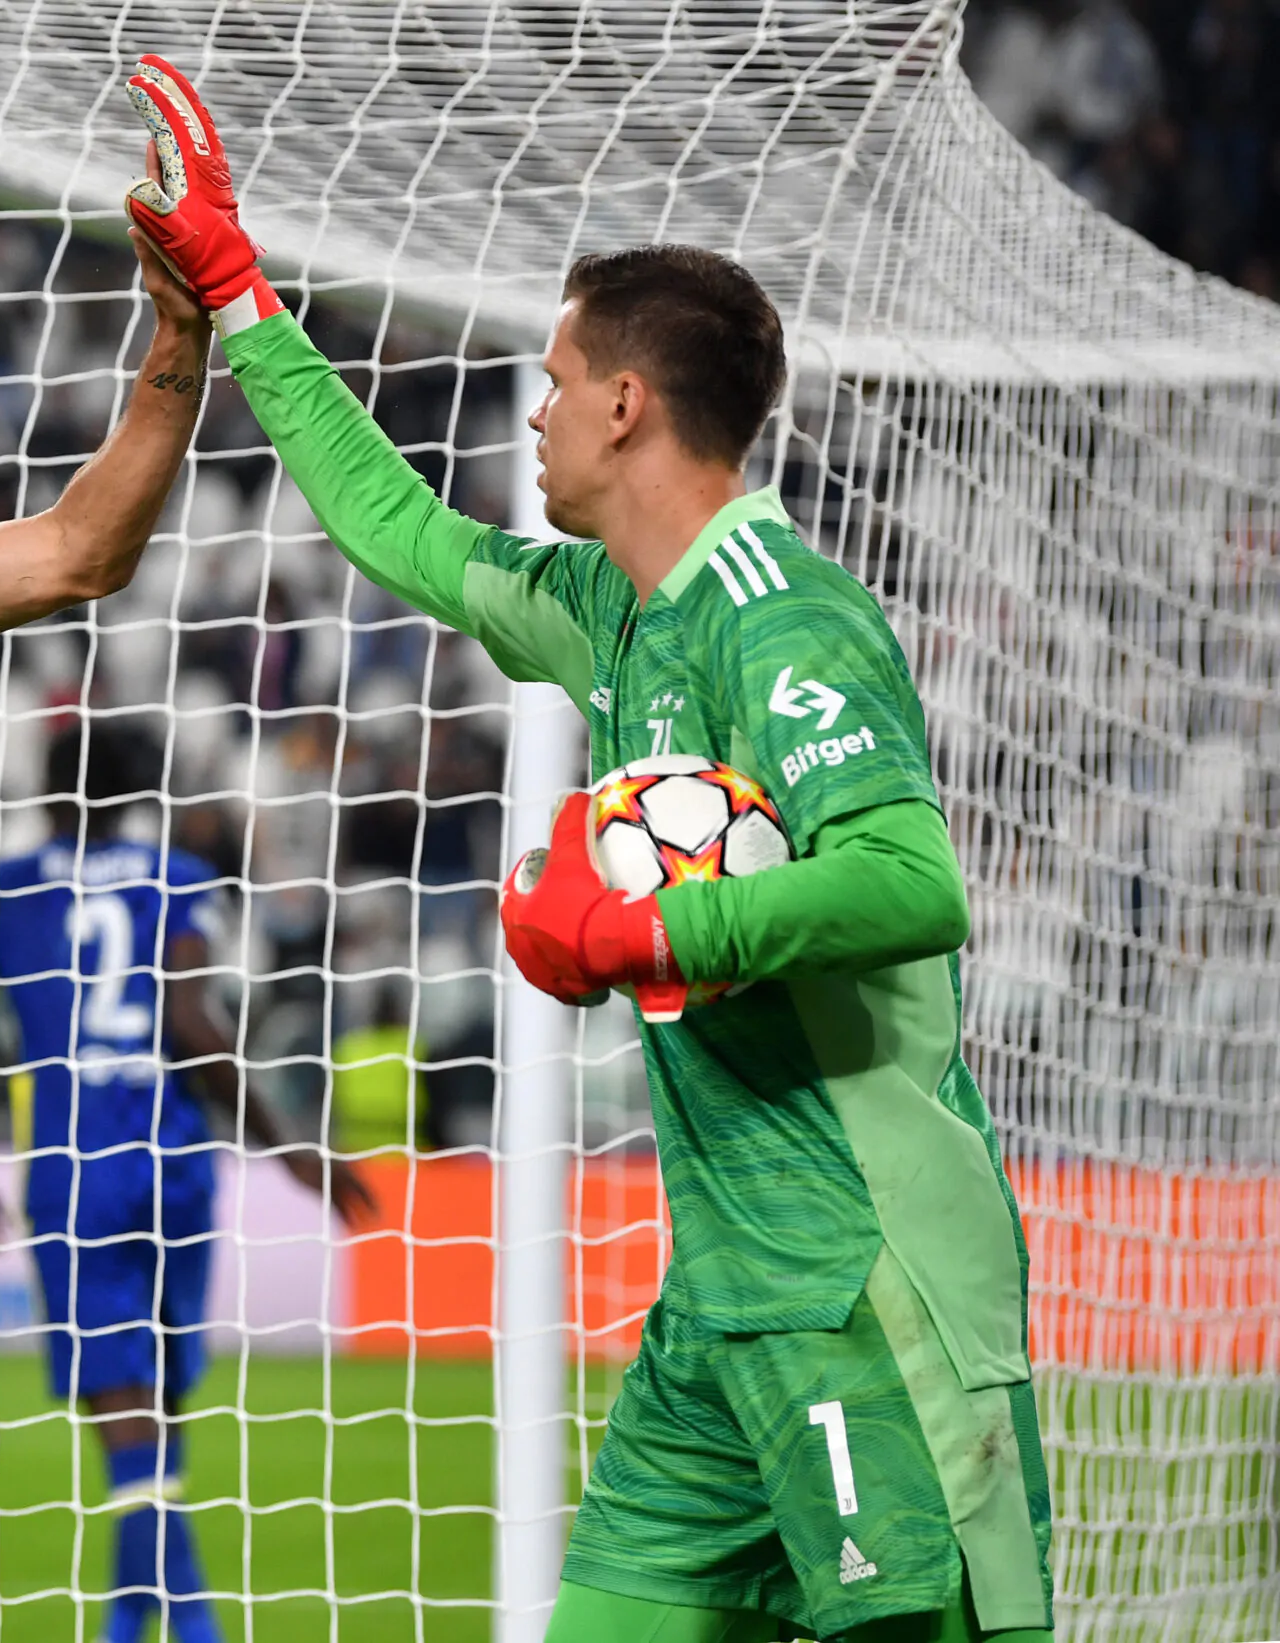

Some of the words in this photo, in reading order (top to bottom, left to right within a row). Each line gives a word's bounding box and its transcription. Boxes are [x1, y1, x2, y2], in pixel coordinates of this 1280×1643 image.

[781, 726, 876, 788] Bitget
[64, 893, 152, 1040] 2
[808, 1400, 859, 1516] 1
[839, 1562, 878, 1585] adidas
